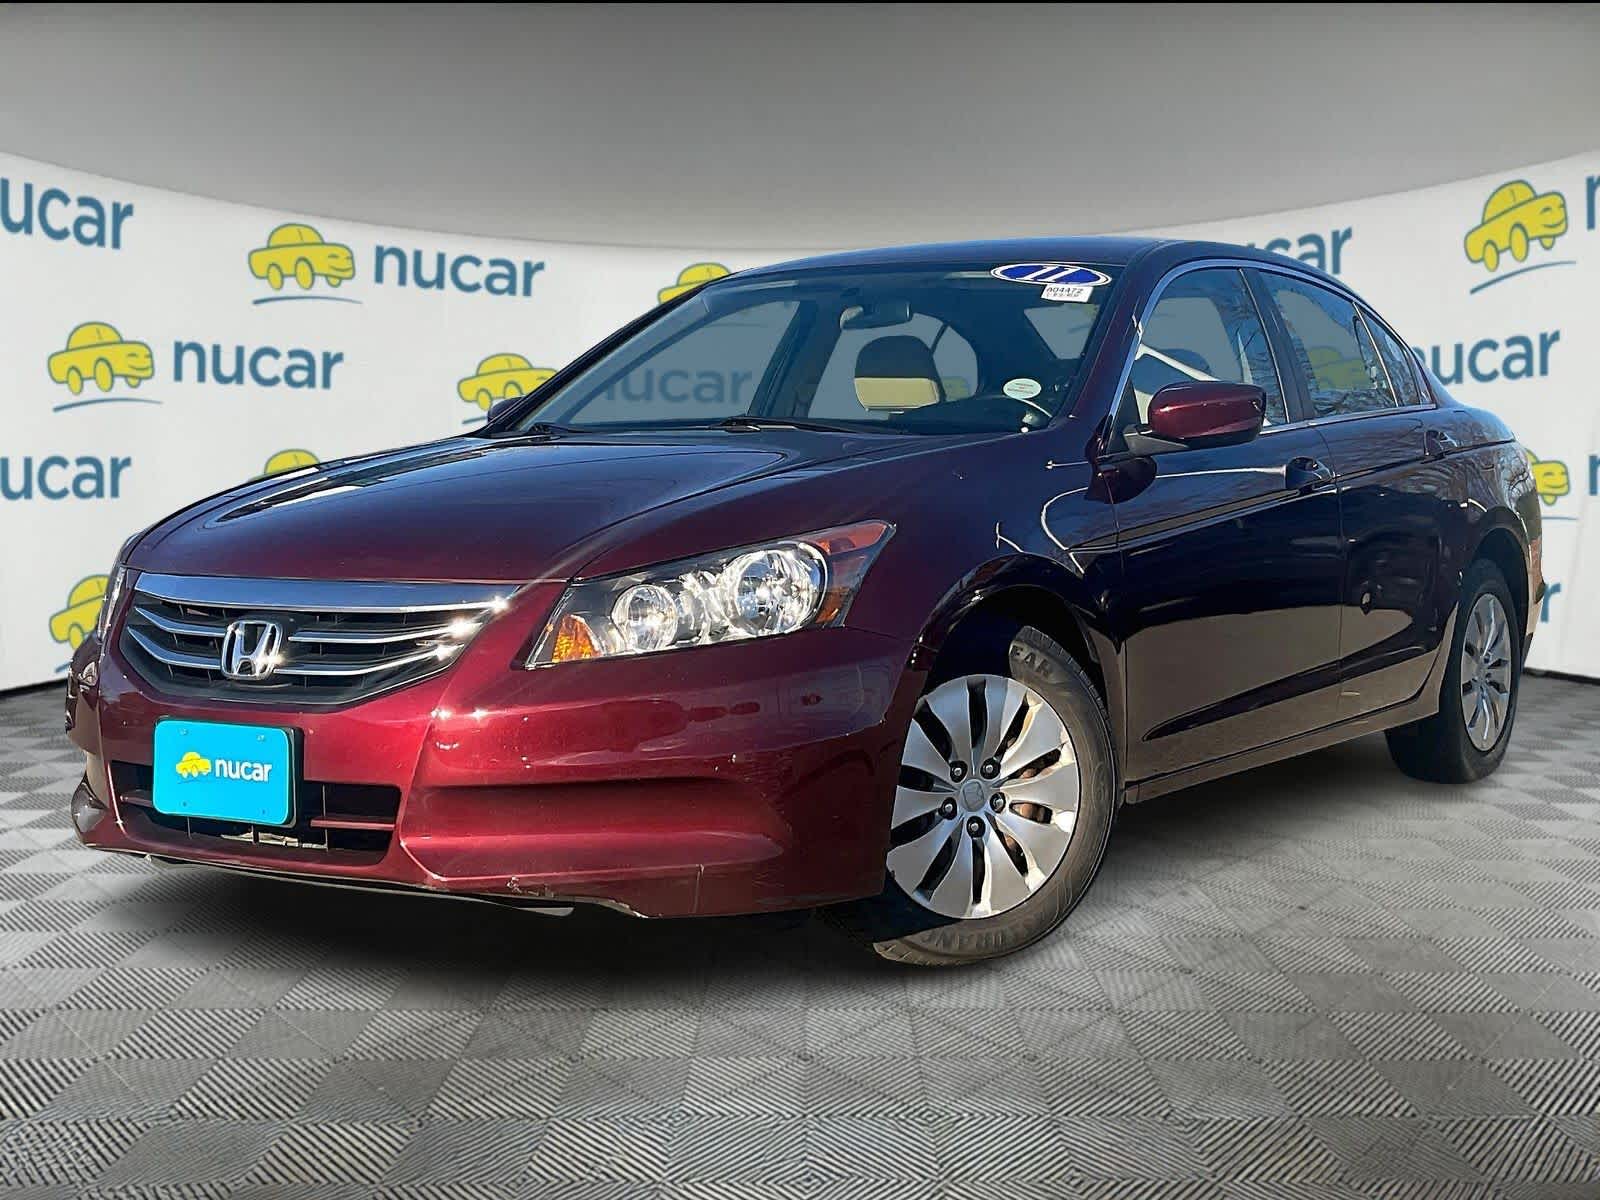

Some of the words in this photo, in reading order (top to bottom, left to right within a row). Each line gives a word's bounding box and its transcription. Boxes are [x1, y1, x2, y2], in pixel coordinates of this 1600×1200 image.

[374, 245, 545, 297] nucar
[173, 340, 344, 389] nucar
[215, 759, 272, 783] nucar
